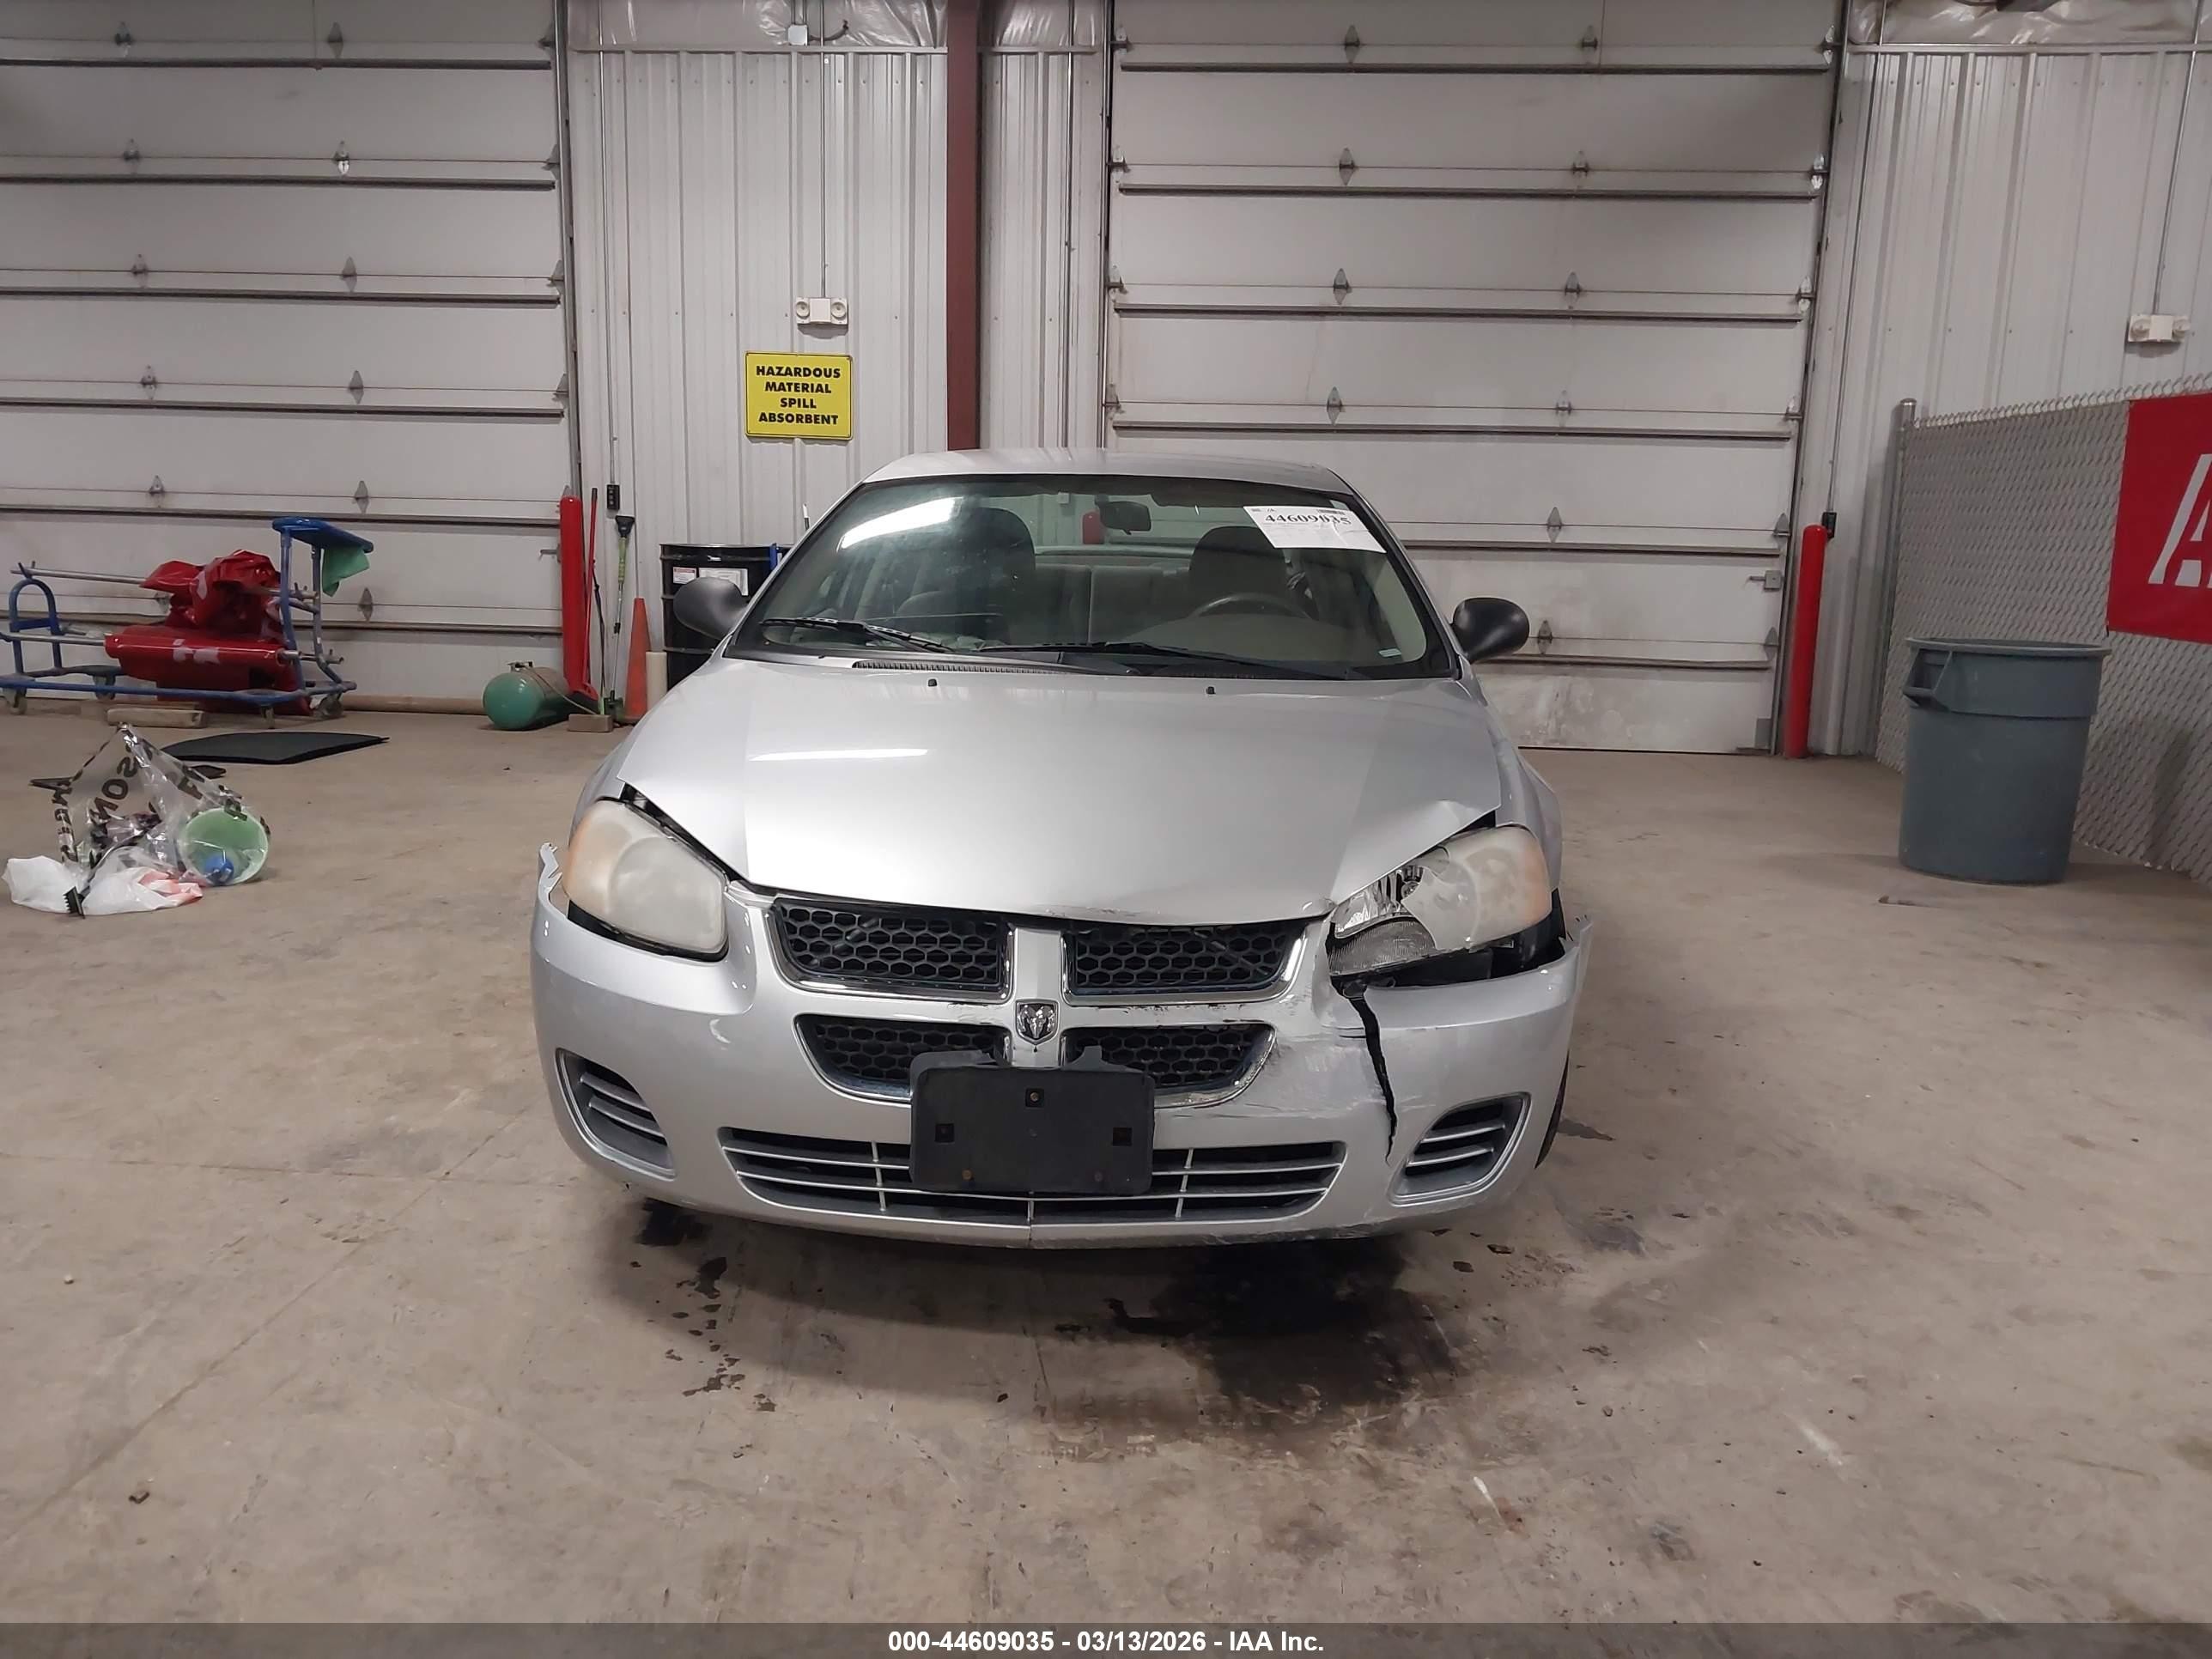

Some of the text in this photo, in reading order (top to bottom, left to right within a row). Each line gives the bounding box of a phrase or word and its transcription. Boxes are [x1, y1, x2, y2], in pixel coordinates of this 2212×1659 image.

[756, 366, 841, 378] HAZARDOUS
[764, 381, 832, 393] MATERIAL
[780, 398, 817, 409] SPILL
[758, 412, 839, 425] ABSORBENT
